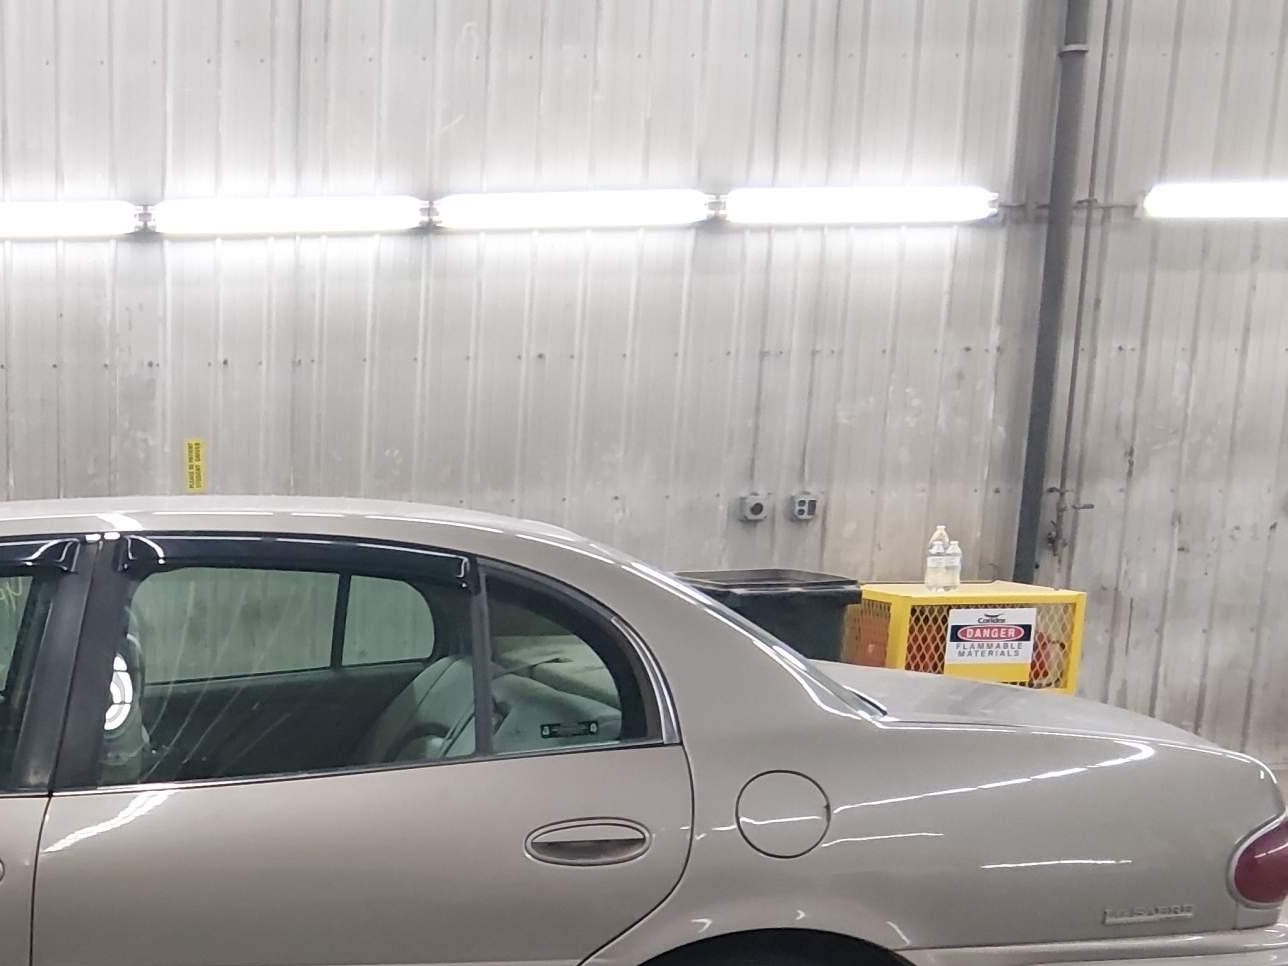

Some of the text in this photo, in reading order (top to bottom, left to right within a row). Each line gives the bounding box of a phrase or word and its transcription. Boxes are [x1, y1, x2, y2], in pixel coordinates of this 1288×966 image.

[965, 628, 1016, 638] DANGER
[955, 642, 1023, 650] FLAMMABLE
[957, 649, 1020, 657] MATERIALS
